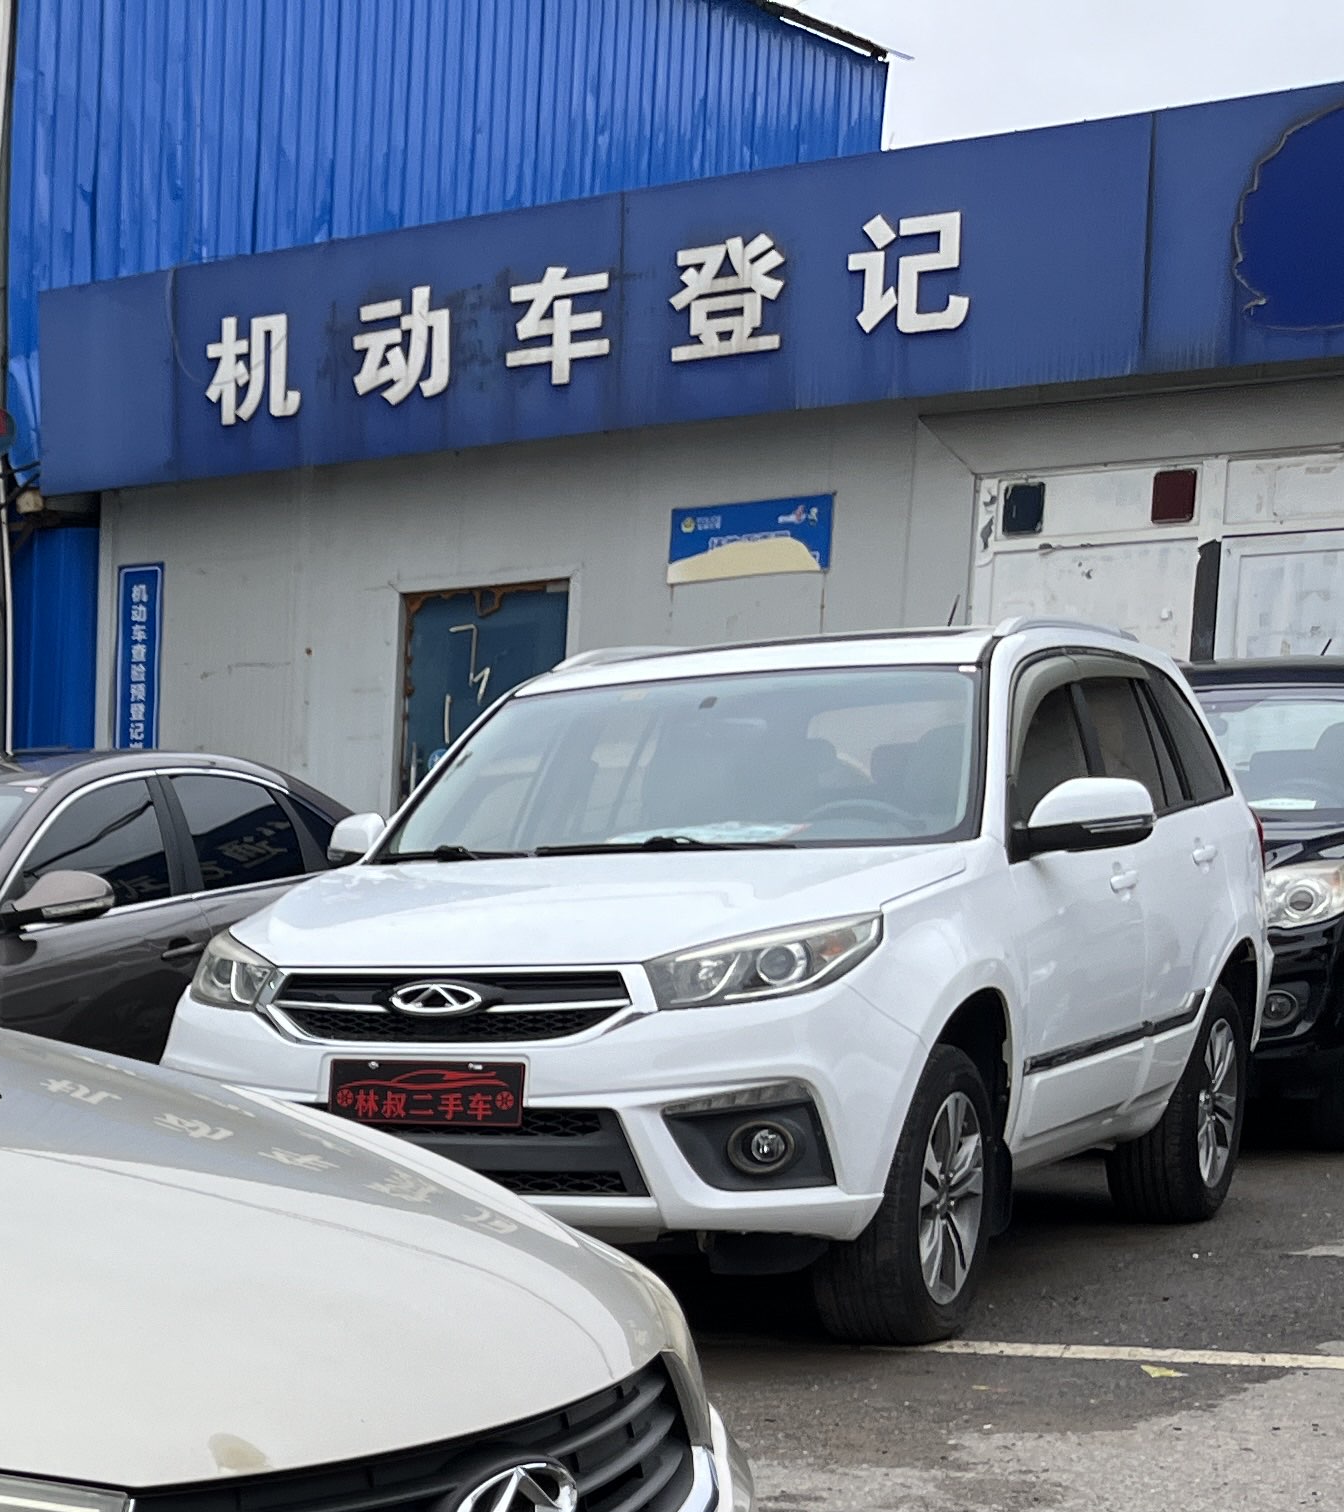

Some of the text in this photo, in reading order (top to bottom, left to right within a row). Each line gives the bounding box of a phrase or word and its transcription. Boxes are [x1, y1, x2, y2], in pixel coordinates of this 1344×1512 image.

[205, 209, 970, 427] 机动车登记
[354, 1088, 494, 1121] 林叔二手车
